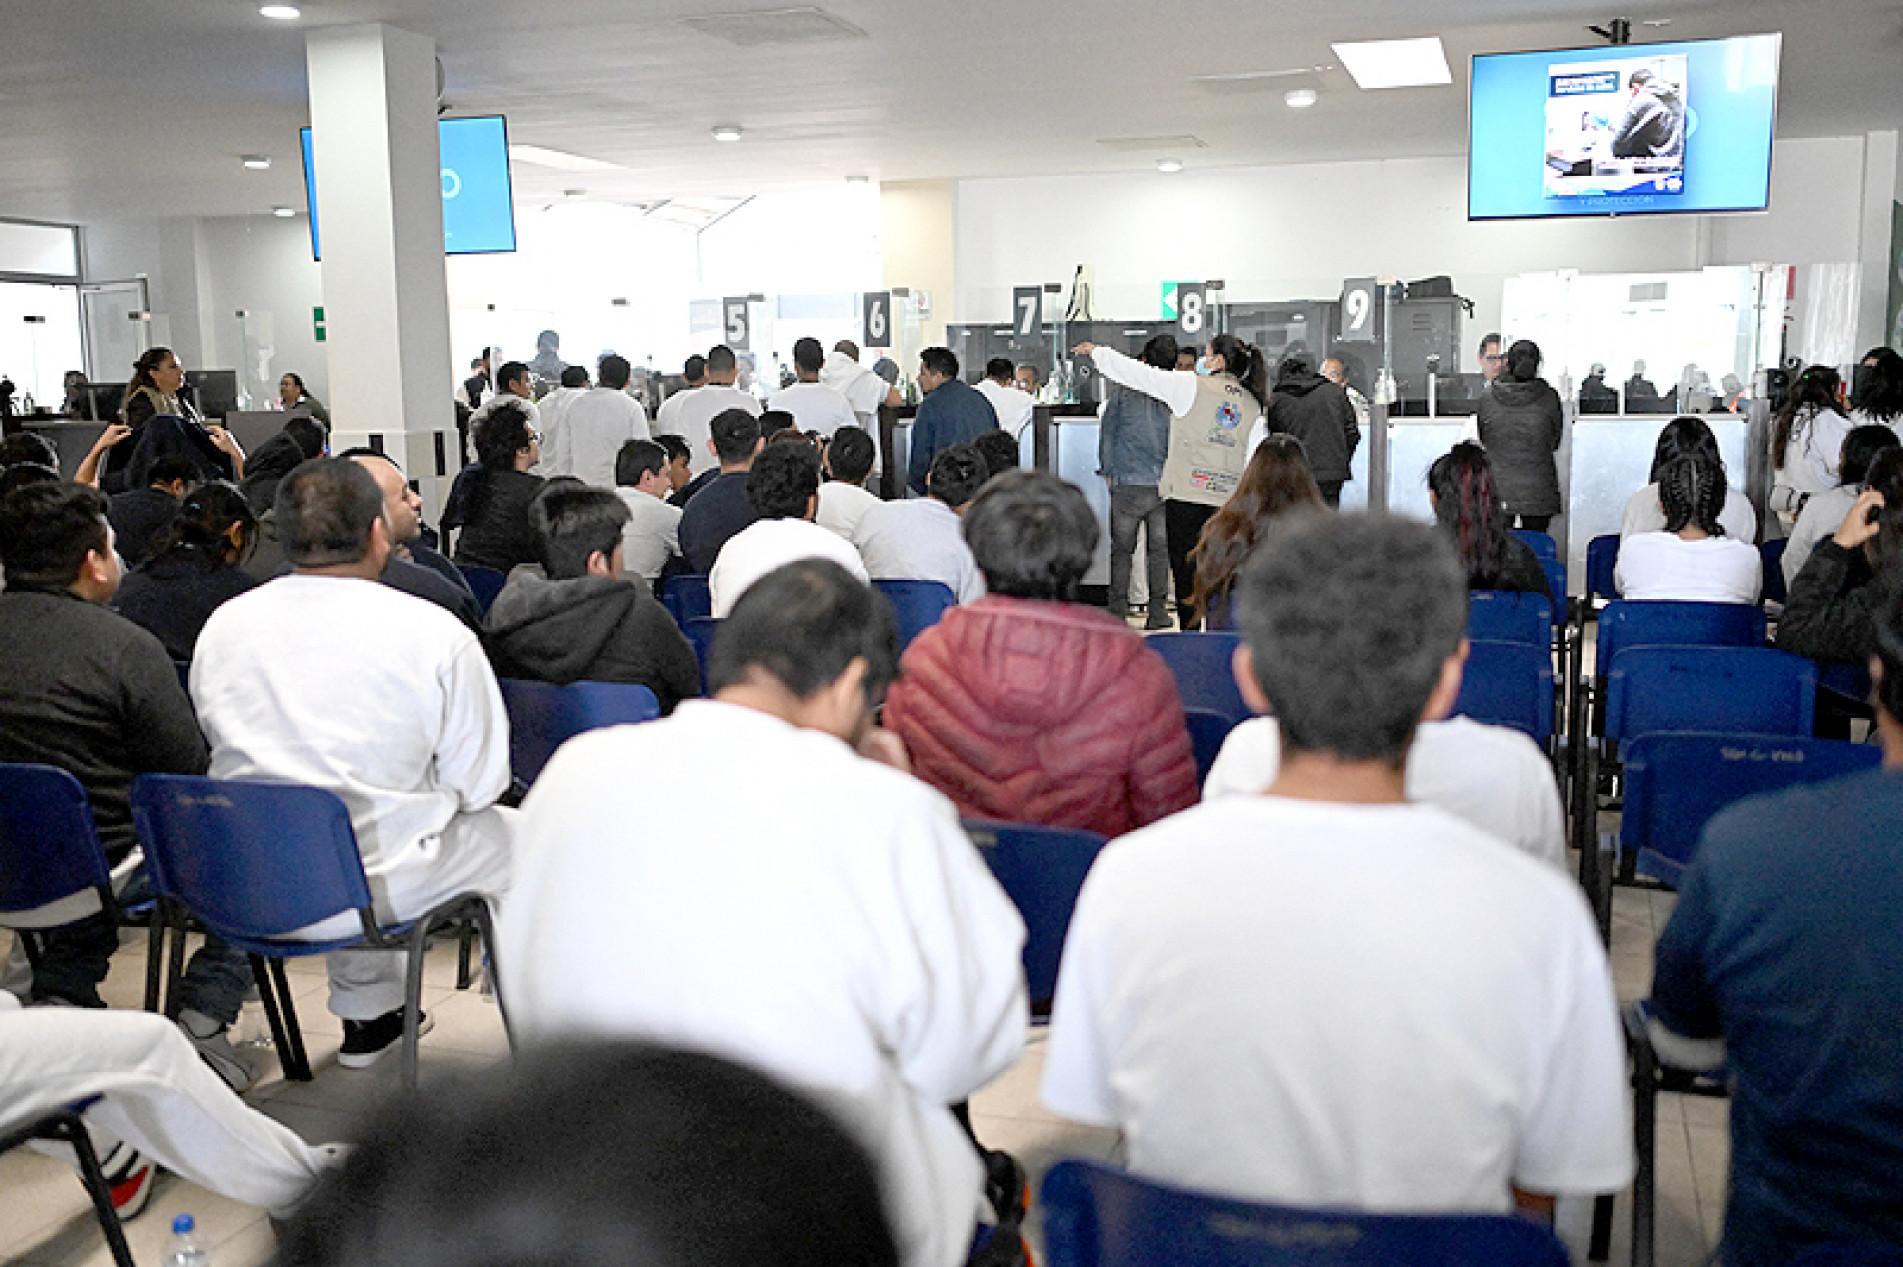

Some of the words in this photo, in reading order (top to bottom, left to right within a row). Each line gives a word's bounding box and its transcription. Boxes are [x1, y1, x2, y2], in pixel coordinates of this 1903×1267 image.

[727, 303, 745, 343] 5
[870, 301, 886, 339] 6
[1017, 296, 1038, 336] 7
[1181, 292, 1202, 334] 8
[1348, 289, 1369, 330] 9
